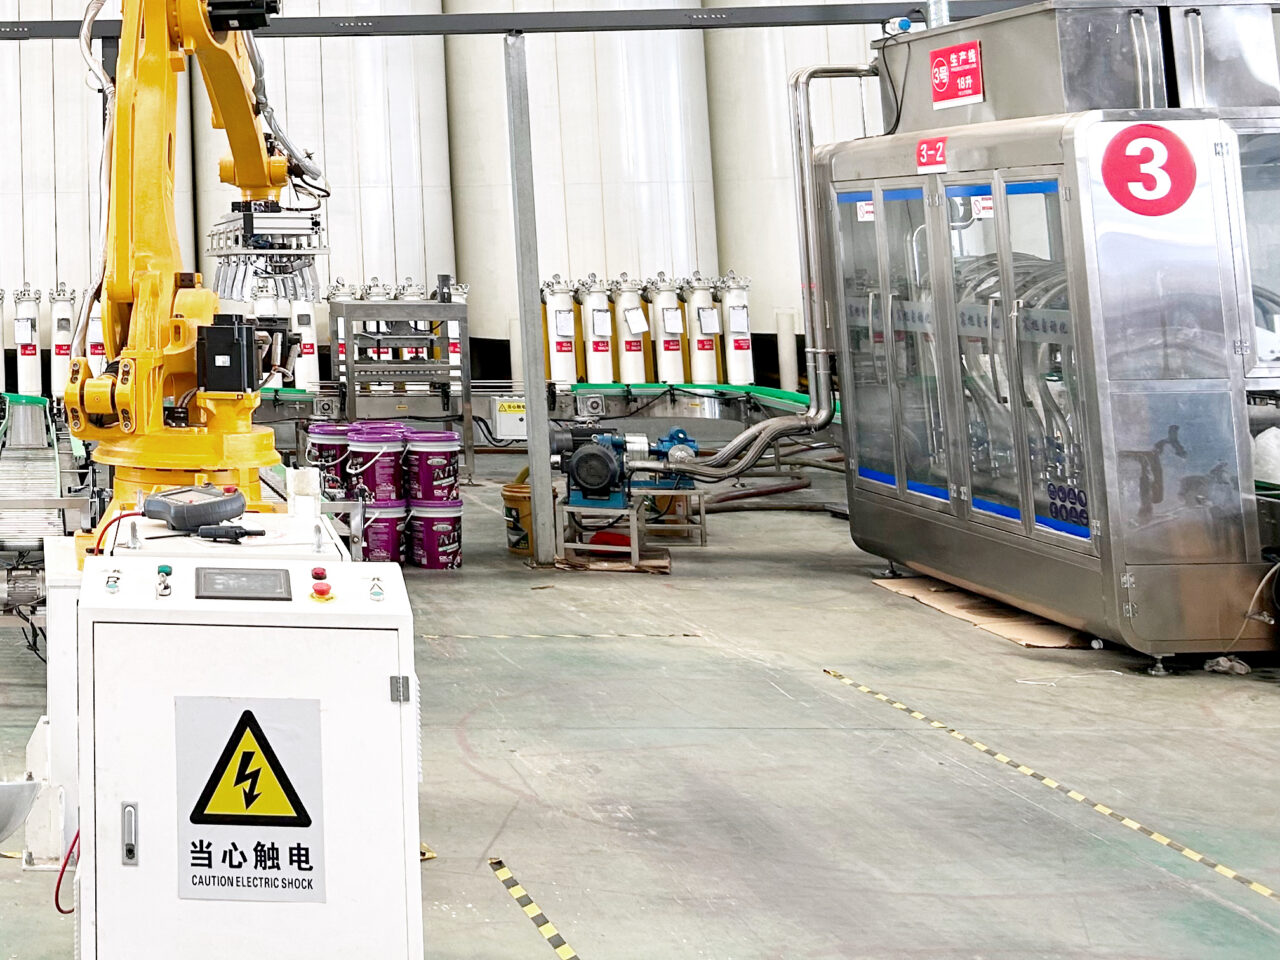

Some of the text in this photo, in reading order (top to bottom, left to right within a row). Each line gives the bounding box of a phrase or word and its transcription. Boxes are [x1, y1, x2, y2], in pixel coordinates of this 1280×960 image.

[950, 48, 976, 67] 生产线
[957, 75, 973, 89] 18升
[920, 141, 944, 162] 3-2
[1125, 137, 1172, 200] 3
[190, 839, 314, 871] 当心触电
[191, 874, 314, 890] CAUTION ELECTRIC SHOCK
